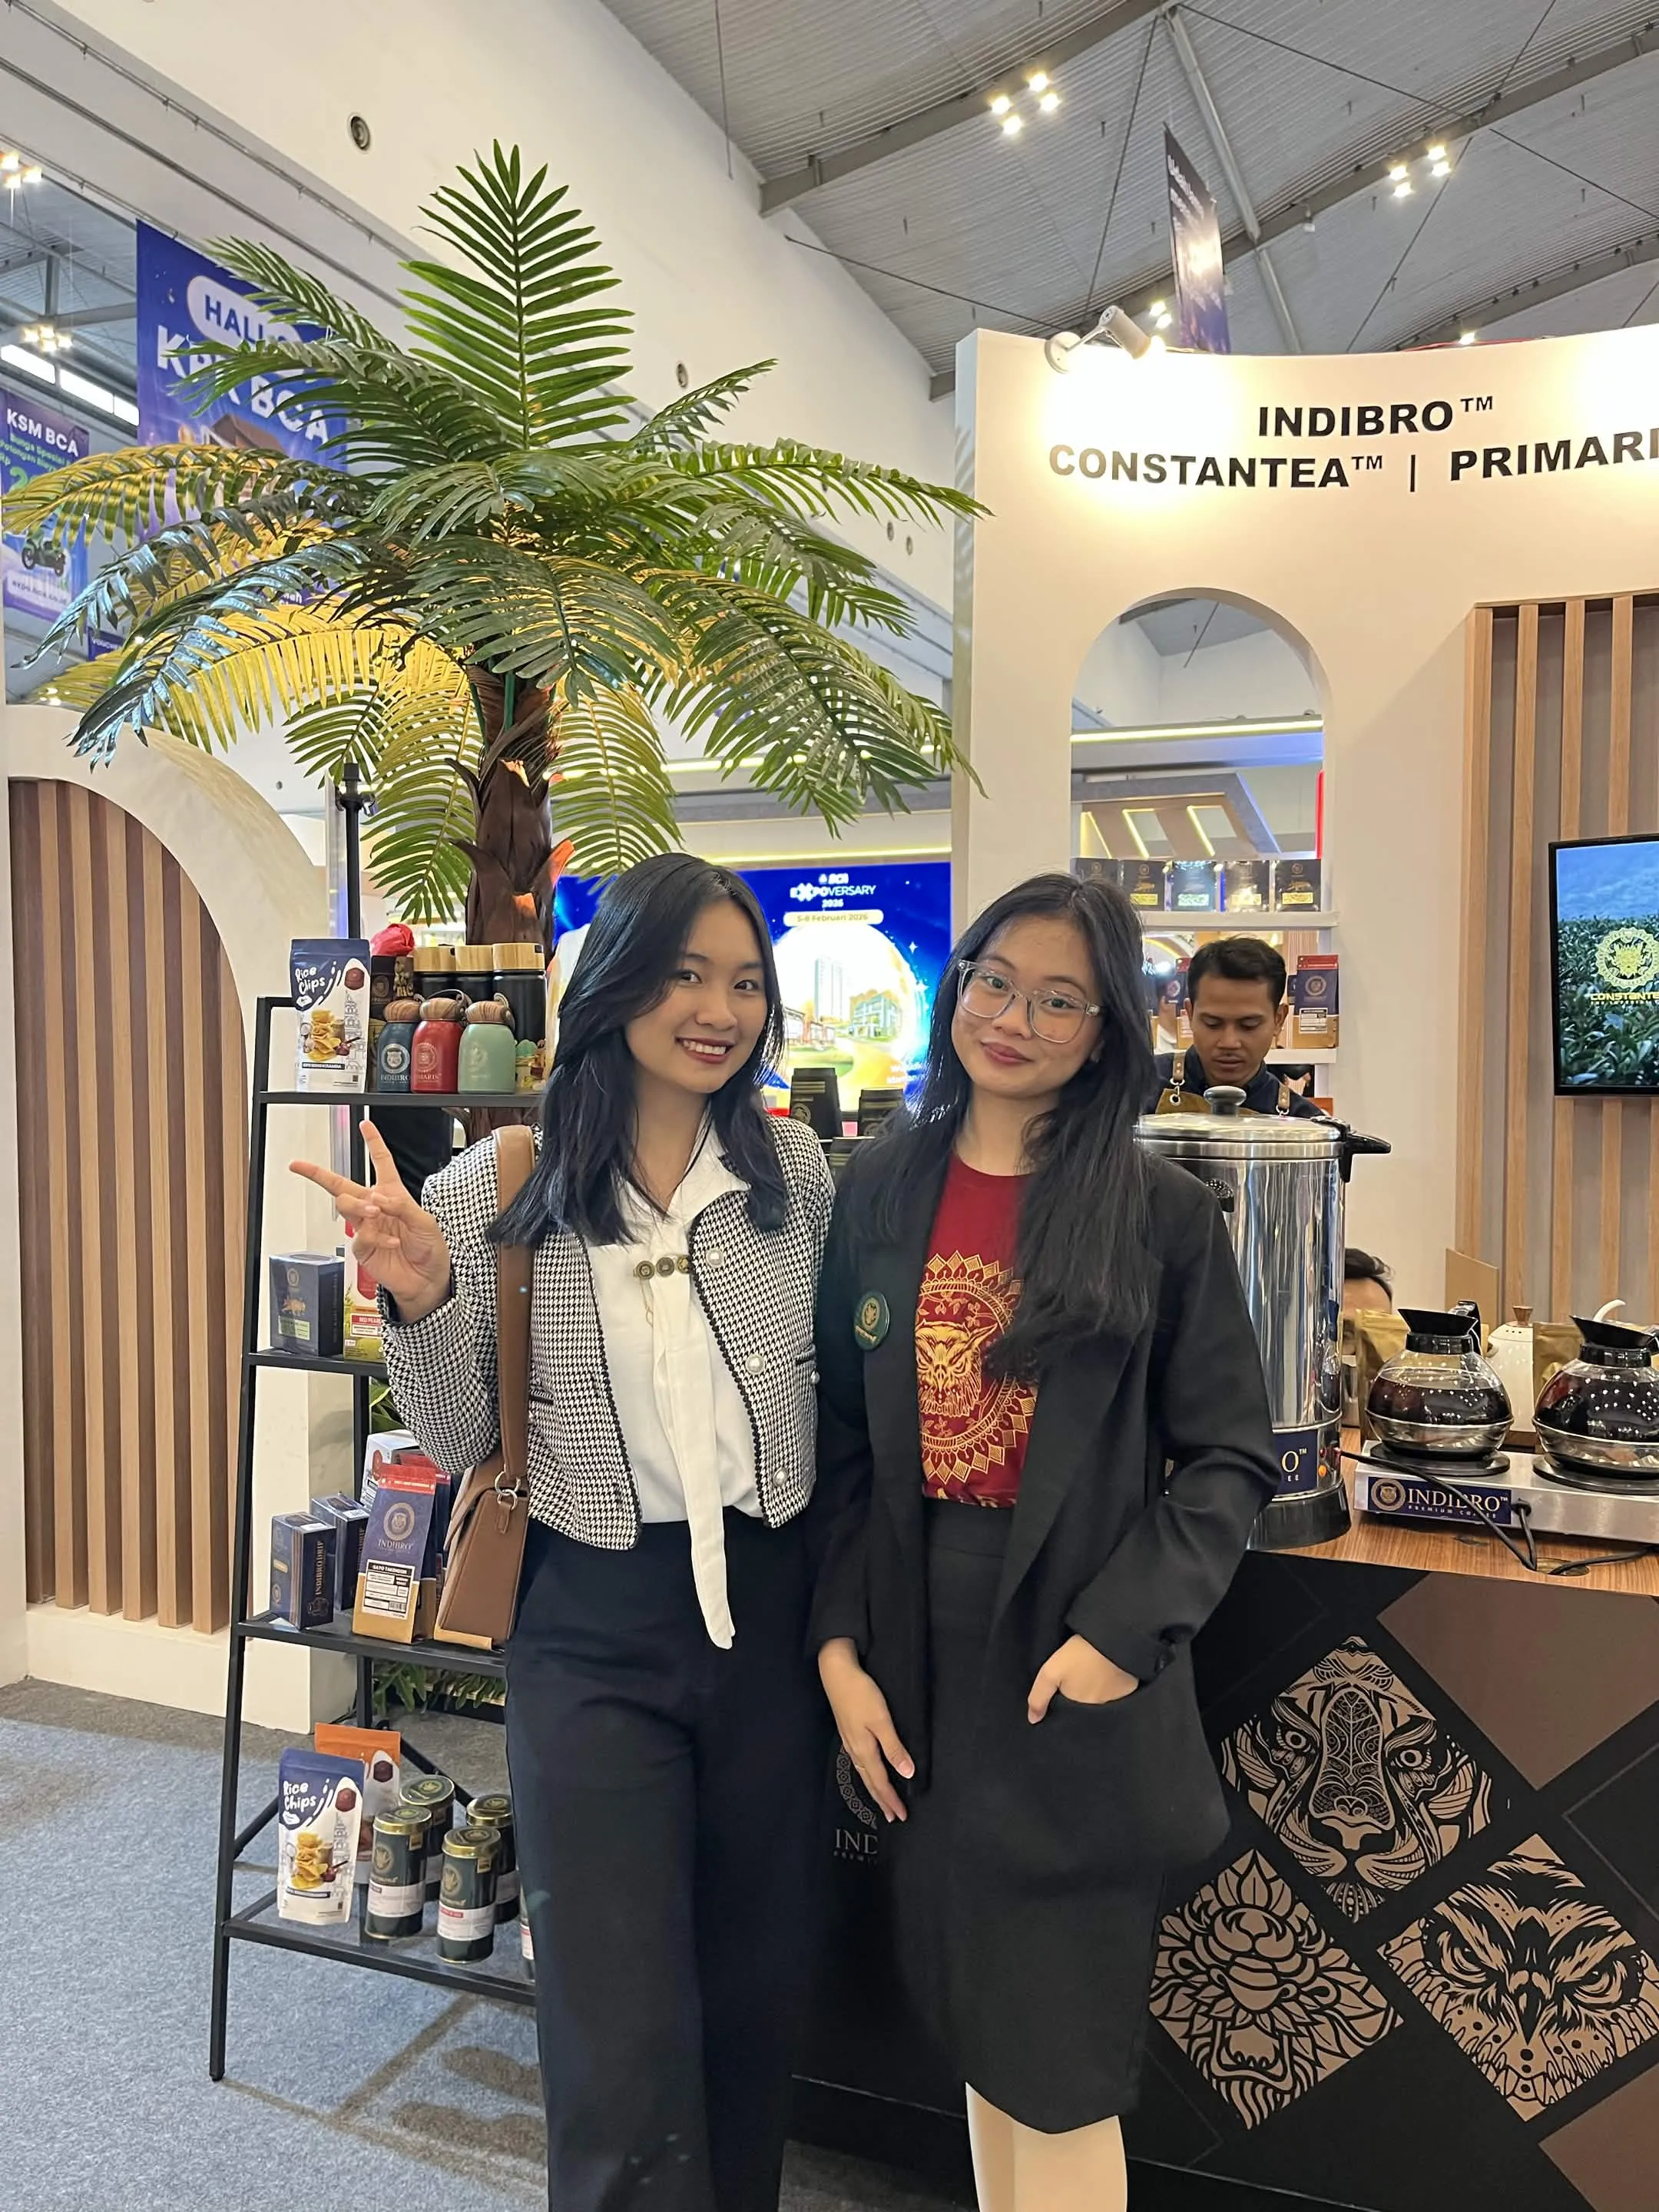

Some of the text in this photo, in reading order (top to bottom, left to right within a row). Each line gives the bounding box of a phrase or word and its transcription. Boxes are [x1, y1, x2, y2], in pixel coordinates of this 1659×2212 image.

[205, 295, 291, 344] HALL
[251, 376, 329, 445] BCA
[6, 409, 78, 457] KSM BCA
[295, 967, 317, 983] Rice
[283, 1780, 309, 1796] Rice
[284, 1795, 316, 1813] Chips
